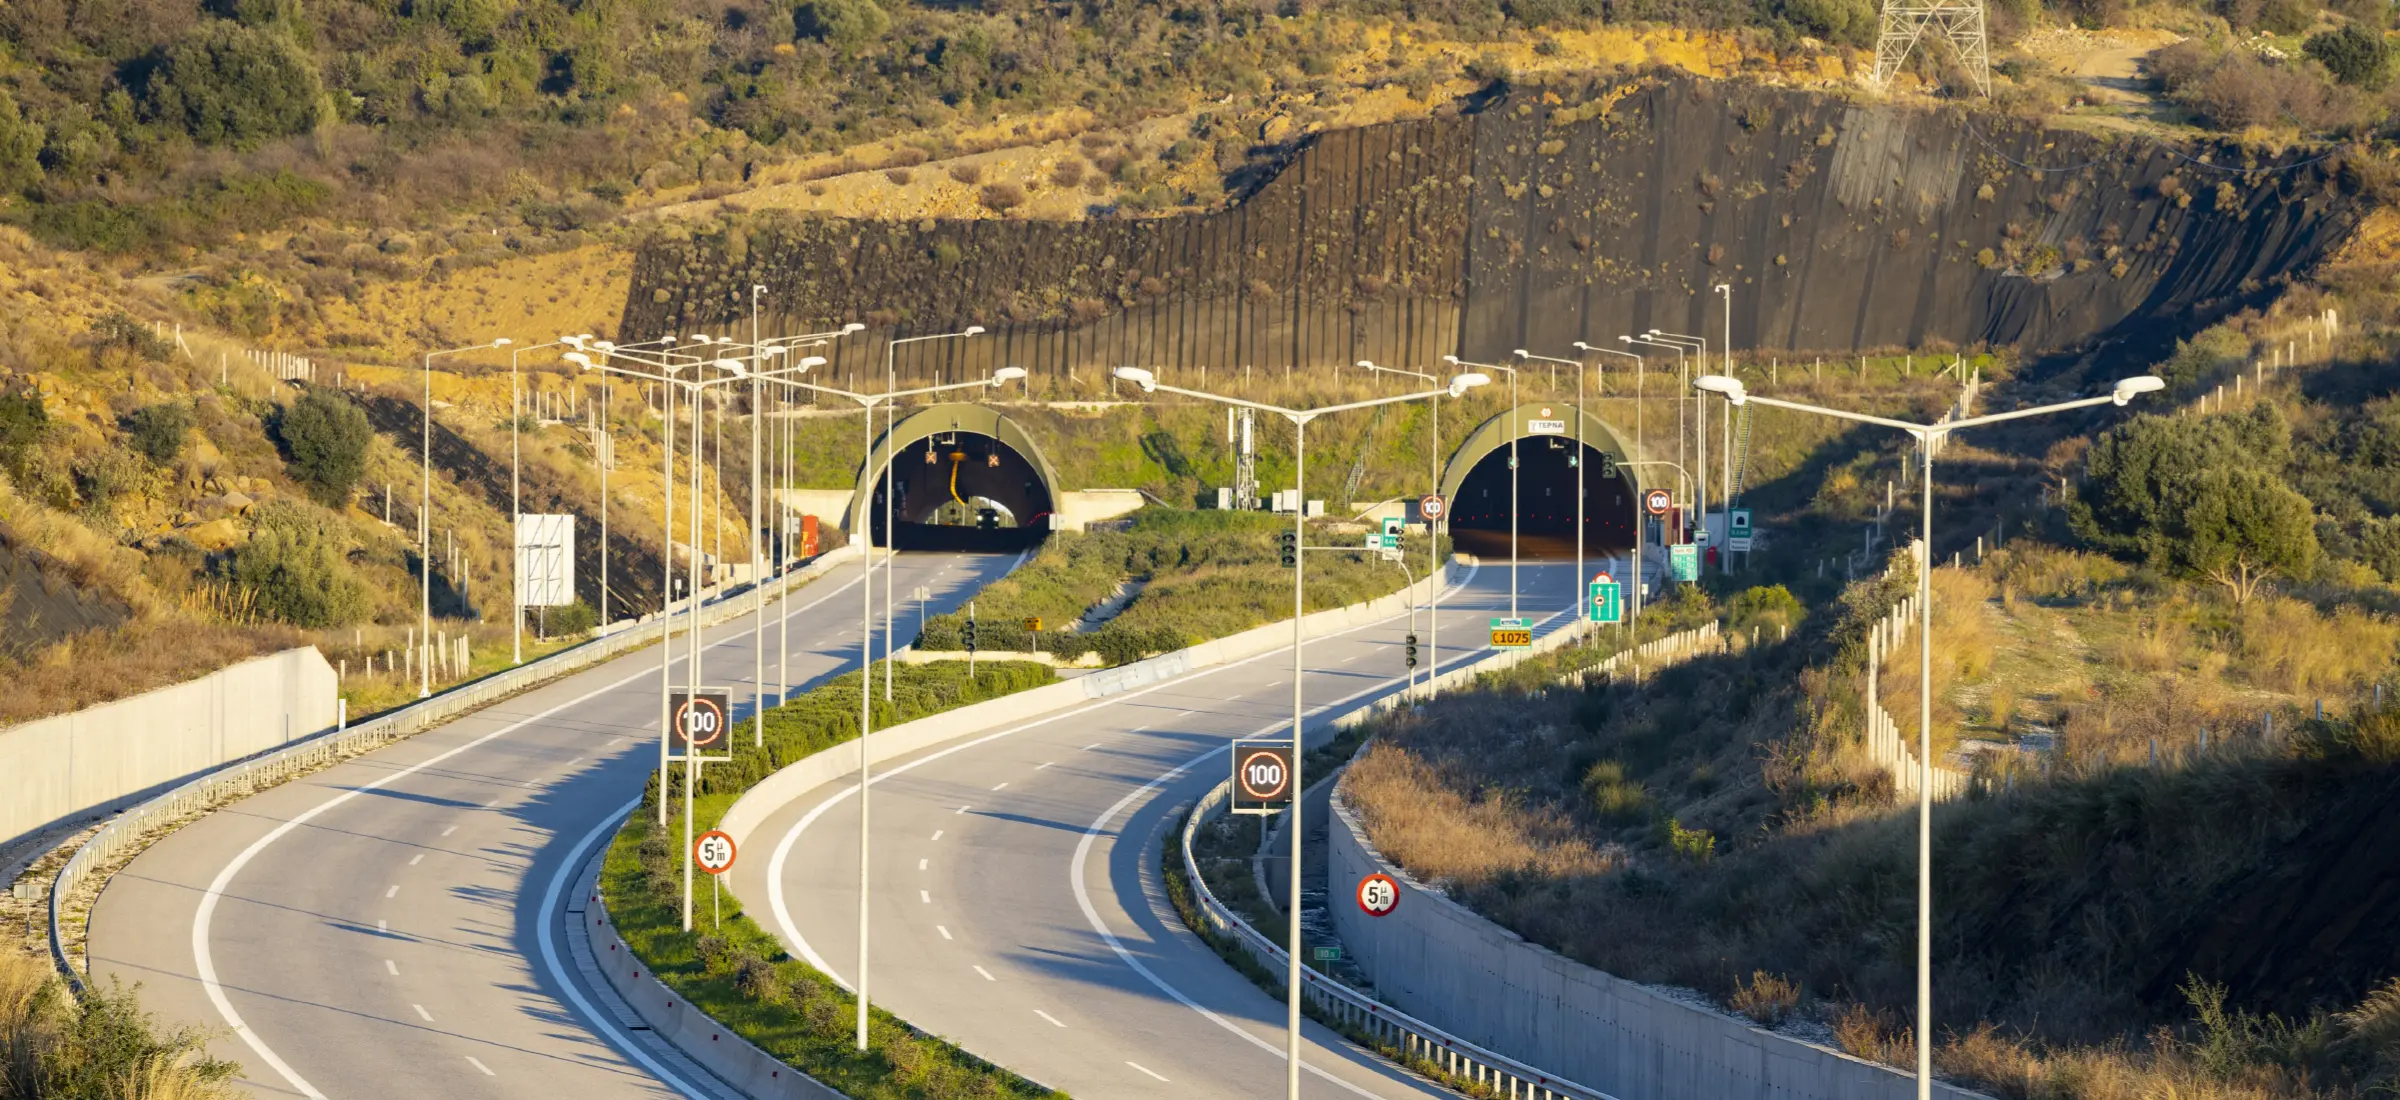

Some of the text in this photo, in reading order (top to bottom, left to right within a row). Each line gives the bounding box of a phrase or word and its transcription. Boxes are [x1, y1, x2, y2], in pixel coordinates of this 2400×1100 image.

[1651, 496, 1667, 508] 100
[1500, 633, 1529, 643] 1075
[1248, 764, 1280, 785] 100
[704, 843, 715, 861] 5
[716, 852, 725, 861] m
[1368, 886, 1378, 905] 5
[1380, 896, 1388, 905] m
